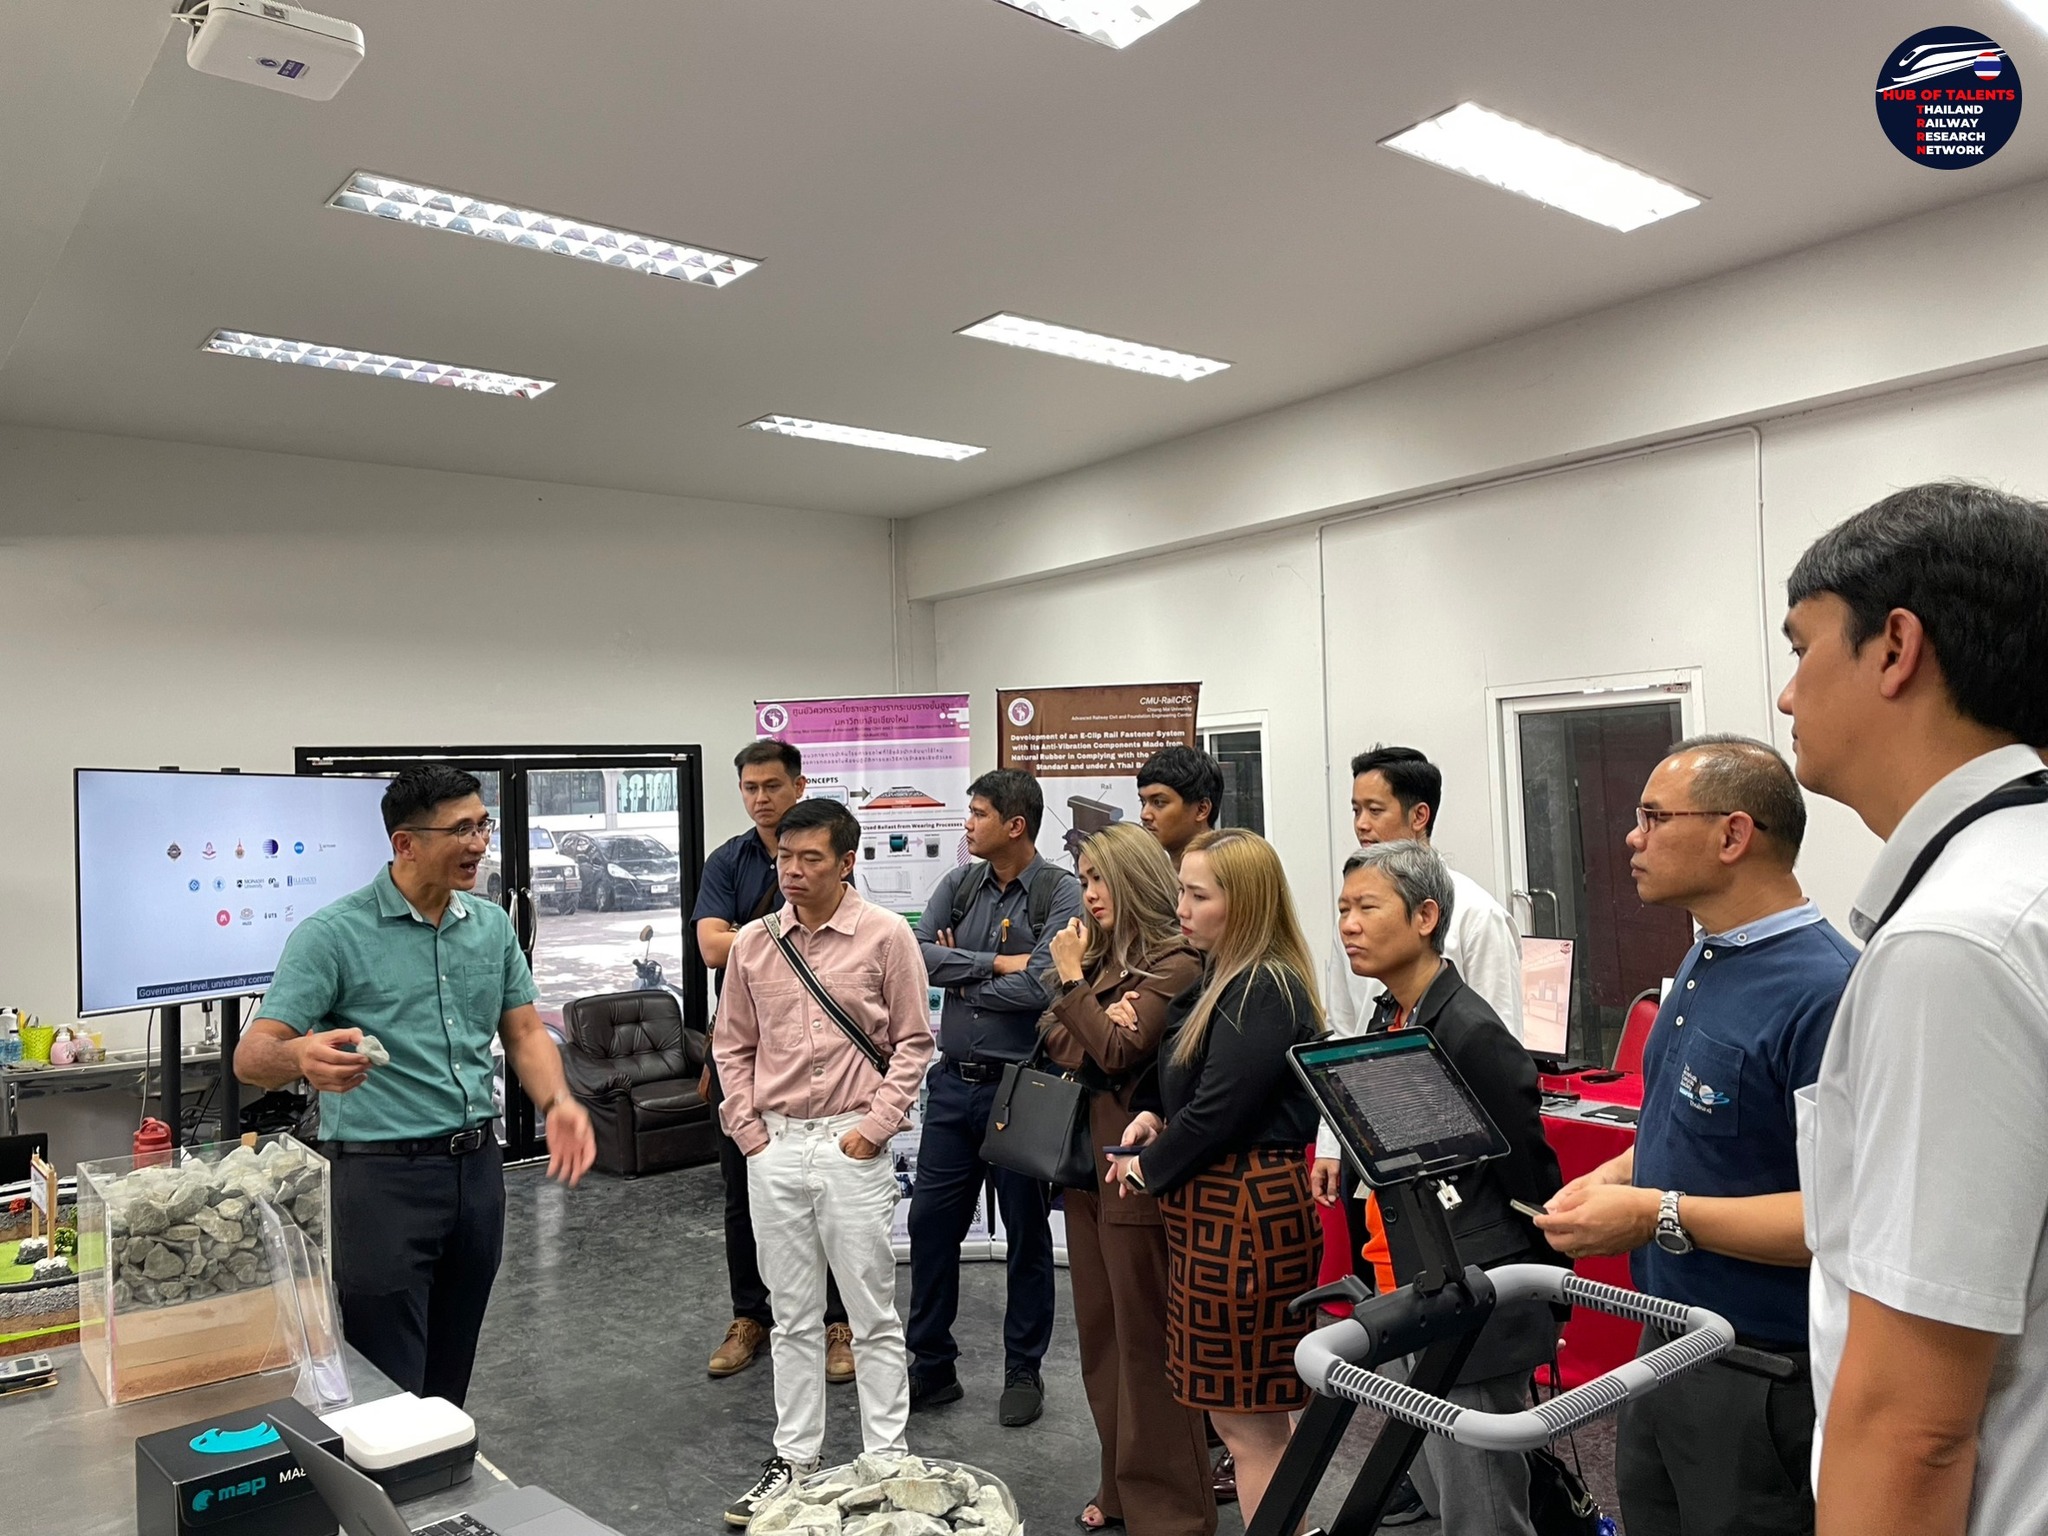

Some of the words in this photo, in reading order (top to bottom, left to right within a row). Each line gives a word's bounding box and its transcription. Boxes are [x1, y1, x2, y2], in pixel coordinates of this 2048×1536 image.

[1139, 695, 1193, 705] CMU-RailCFC
[1010, 733, 1058, 742] Development
[1080, 732, 1102, 740] E-Clip
[1120, 730, 1154, 738] Fastener
[1156, 730, 1185, 738] System
[1011, 743, 1029, 751] with
[1041, 742, 1092, 750] Anti-Vibration
[1093, 741, 1141, 750] Components
[1142, 740, 1164, 748] Made
[1011, 753, 1039, 761] Natural
[1040, 752, 1066, 760] Rubber
[1076, 751, 1116, 760] Complying
[1136, 750, 1149, 758] the
[1036, 762, 1069, 770] Standard
[1070, 762, 1085, 770] and
[1085, 762, 1108, 770] under
[1108, 761, 1115, 769] A
[1116, 761, 1134, 769] Thai
[804, 777, 839, 785] ONCEPTS
[138, 984, 189, 998] Government
[189, 981, 211, 993] level,
[210, 977, 248, 990] university
[219, 1477, 266, 1501] map
